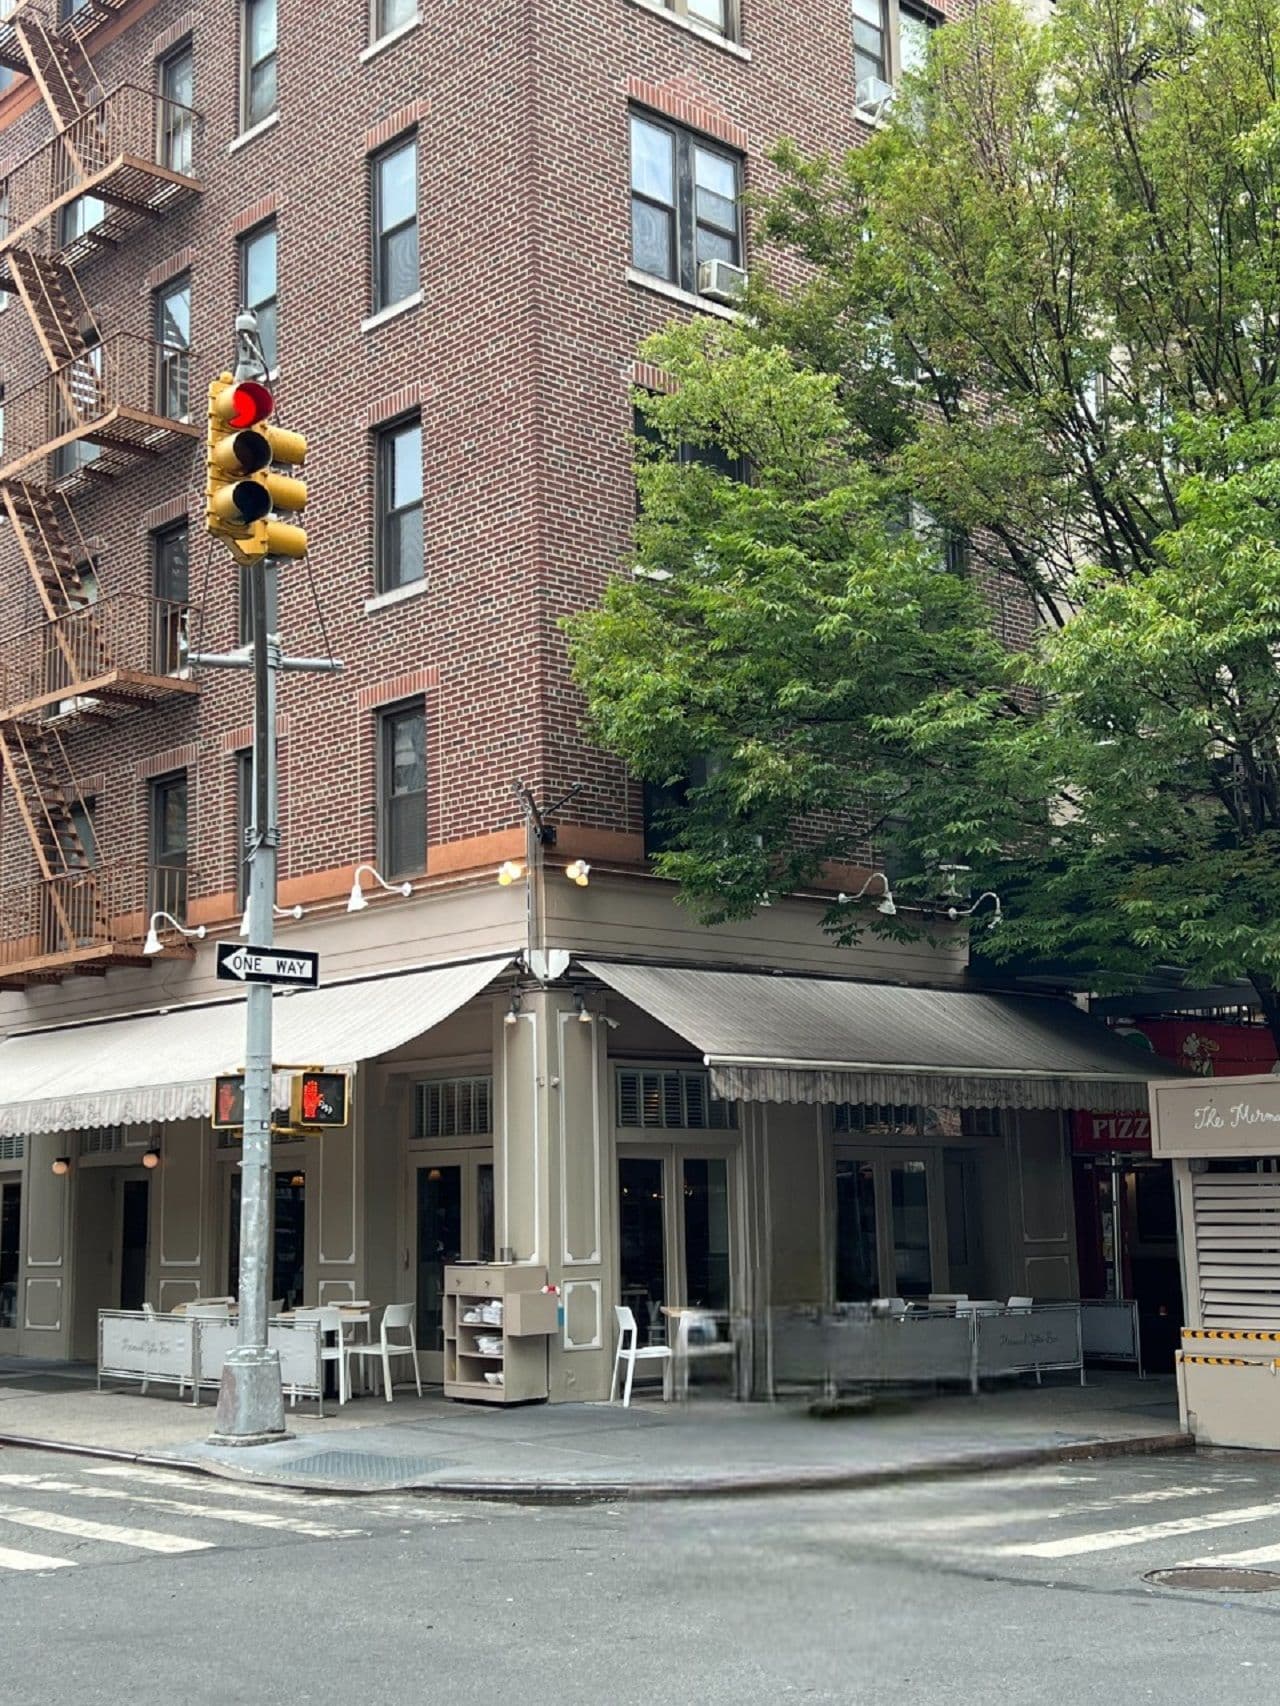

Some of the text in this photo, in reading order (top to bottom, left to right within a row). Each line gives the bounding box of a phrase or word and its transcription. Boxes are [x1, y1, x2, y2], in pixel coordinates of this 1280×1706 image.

[232, 956, 306, 975] ONE WAY
[1092, 1117, 1150, 1139] PIZZ
[1194, 1105, 1224, 1129] The
